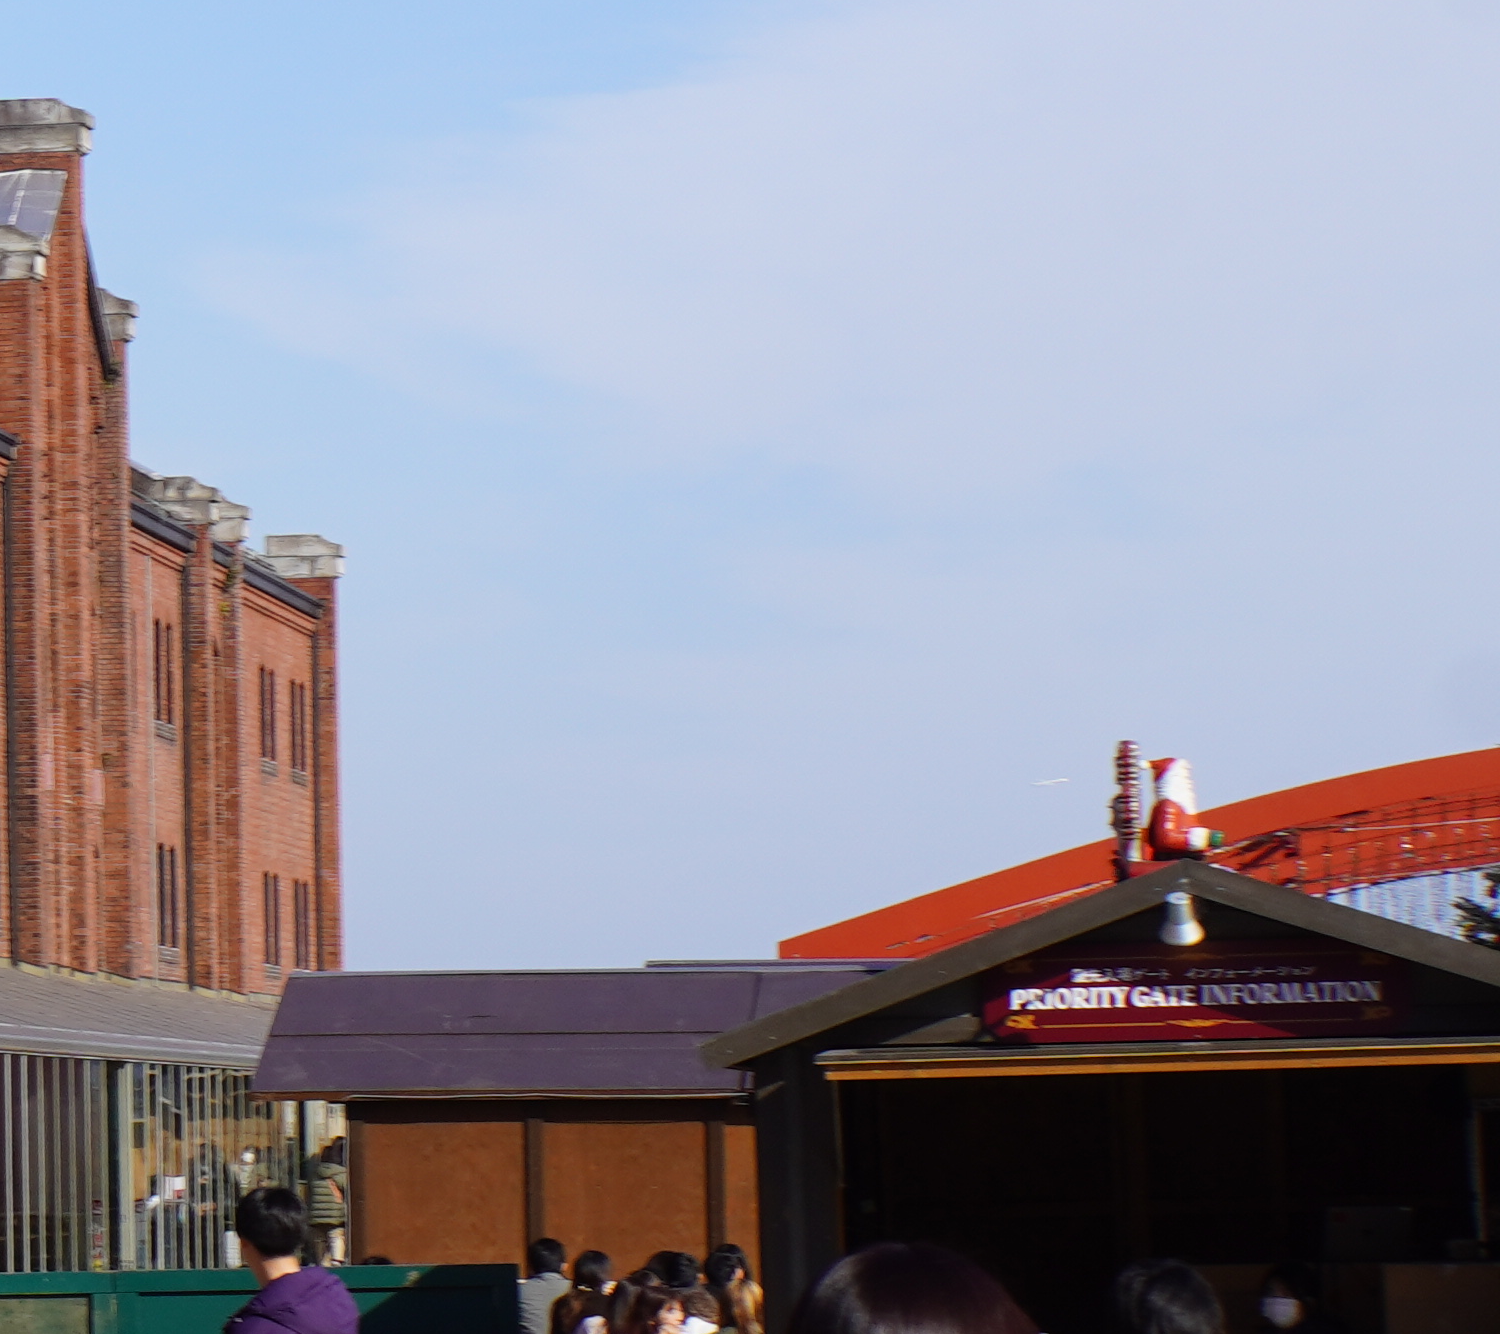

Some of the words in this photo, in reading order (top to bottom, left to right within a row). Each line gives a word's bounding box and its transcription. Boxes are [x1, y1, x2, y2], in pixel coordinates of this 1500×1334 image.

[1008, 986, 1130, 1010] PRIORITY
[1131, 985, 1198, 1007] GATE
[1200, 980, 1382, 1005] INFORMATION
